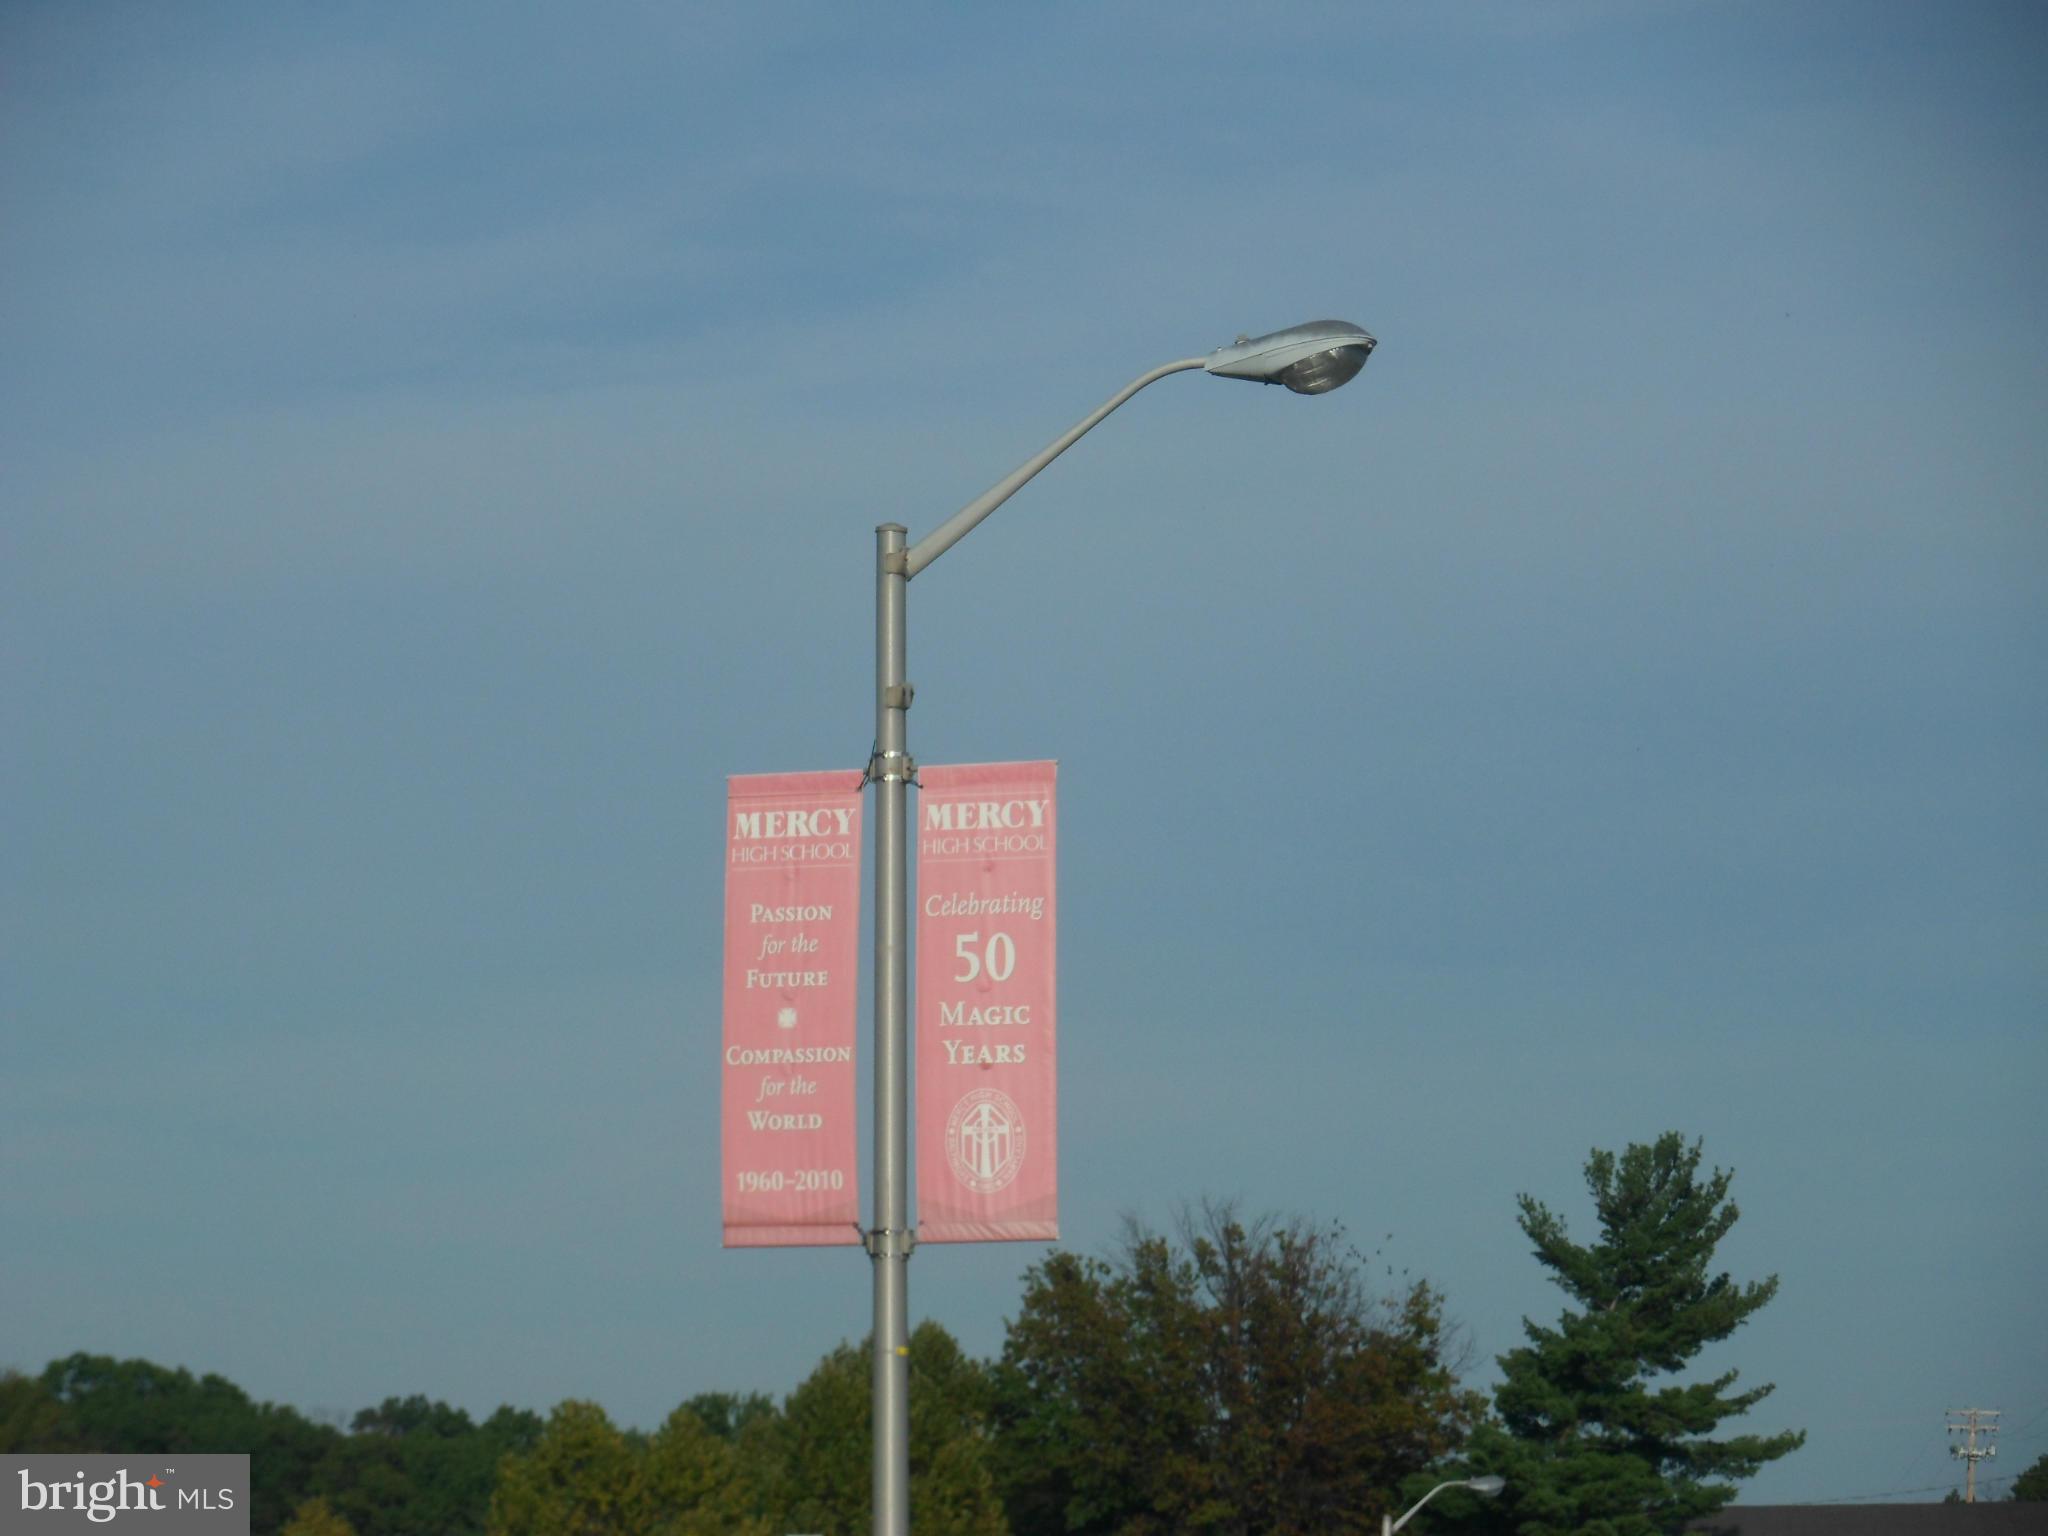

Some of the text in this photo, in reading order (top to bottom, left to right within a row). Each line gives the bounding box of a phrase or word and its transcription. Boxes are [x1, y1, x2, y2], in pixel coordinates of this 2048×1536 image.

[733, 808, 856, 840] MERCY
[925, 800, 1049, 832] MERCY
[731, 841, 854, 863] HIGH SCHOOL
[922, 833, 1048, 856] HIGH SCHOOL
[925, 893, 1045, 920] Celebrating
[758, 934, 819, 961] for the
[955, 931, 1016, 983] 50
[756, 1076, 817, 1102] for the
